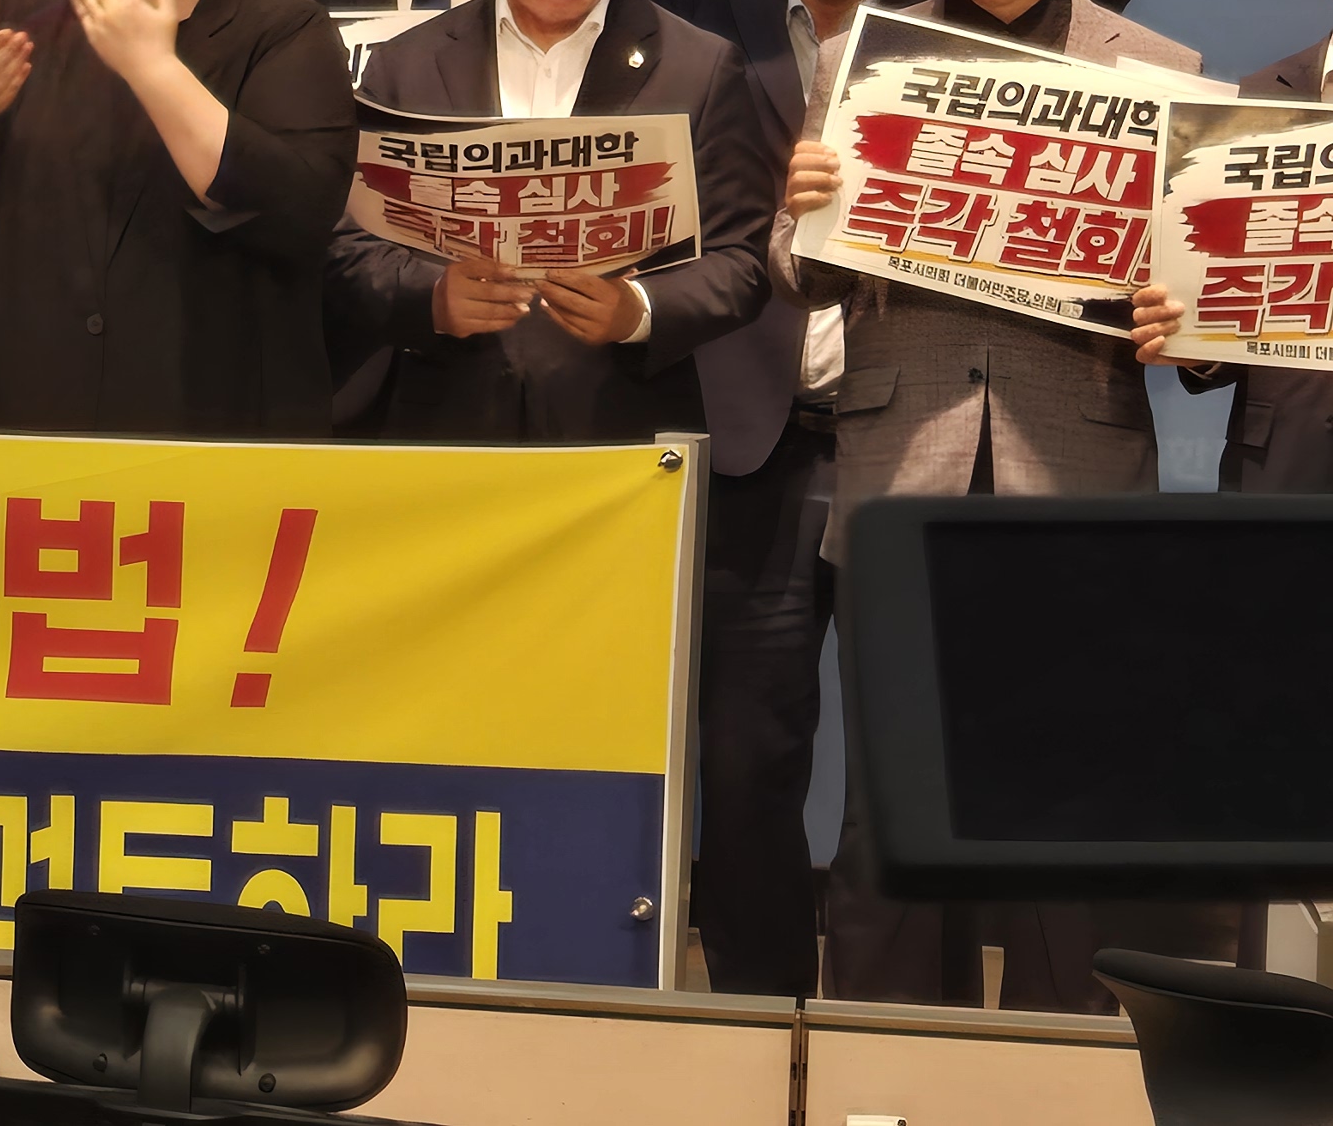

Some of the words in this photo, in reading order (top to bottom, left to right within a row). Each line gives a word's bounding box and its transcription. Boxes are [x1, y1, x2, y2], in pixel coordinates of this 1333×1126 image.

[378, 131, 639, 172] 국립의과대학
[905, 123, 1017, 185] 졸속
[1029, 142, 1136, 202] 심사
[517, 172, 620, 211] 심사
[845, 179, 995, 260] 즉각
[517, 205, 675, 267] 철회!
[1197, 262, 1333, 334] 즉각
